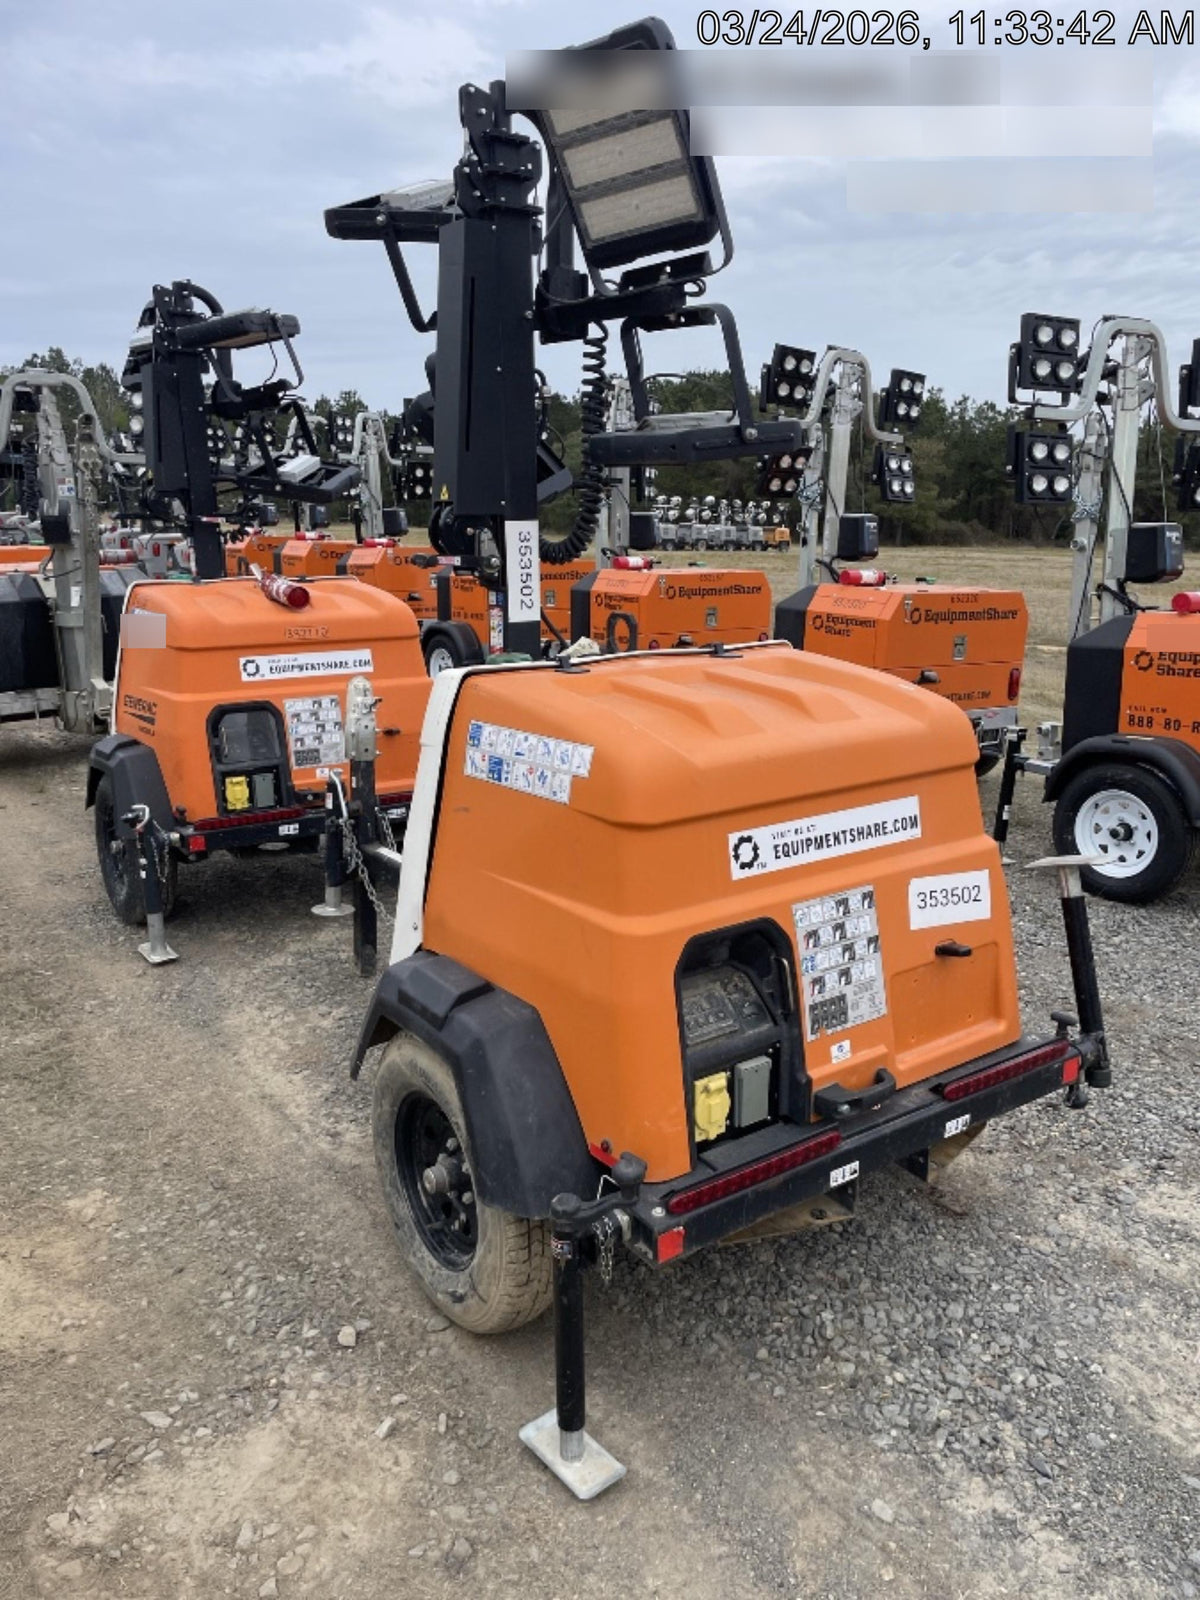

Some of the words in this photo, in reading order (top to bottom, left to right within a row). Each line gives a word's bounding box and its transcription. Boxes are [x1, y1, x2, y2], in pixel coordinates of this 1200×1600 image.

[518, 531, 534, 610] 353502
[678, 583, 762, 599] EquipmentShare
[825, 613, 876, 629] Equipment
[924, 607, 1018, 625] EquipmentShare
[824, 625, 852, 637] Share
[1156, 664, 1200, 678] Share
[773, 814, 919, 860] EQUIPMENTSHARE.COM
[916, 884, 983, 910] 353502
